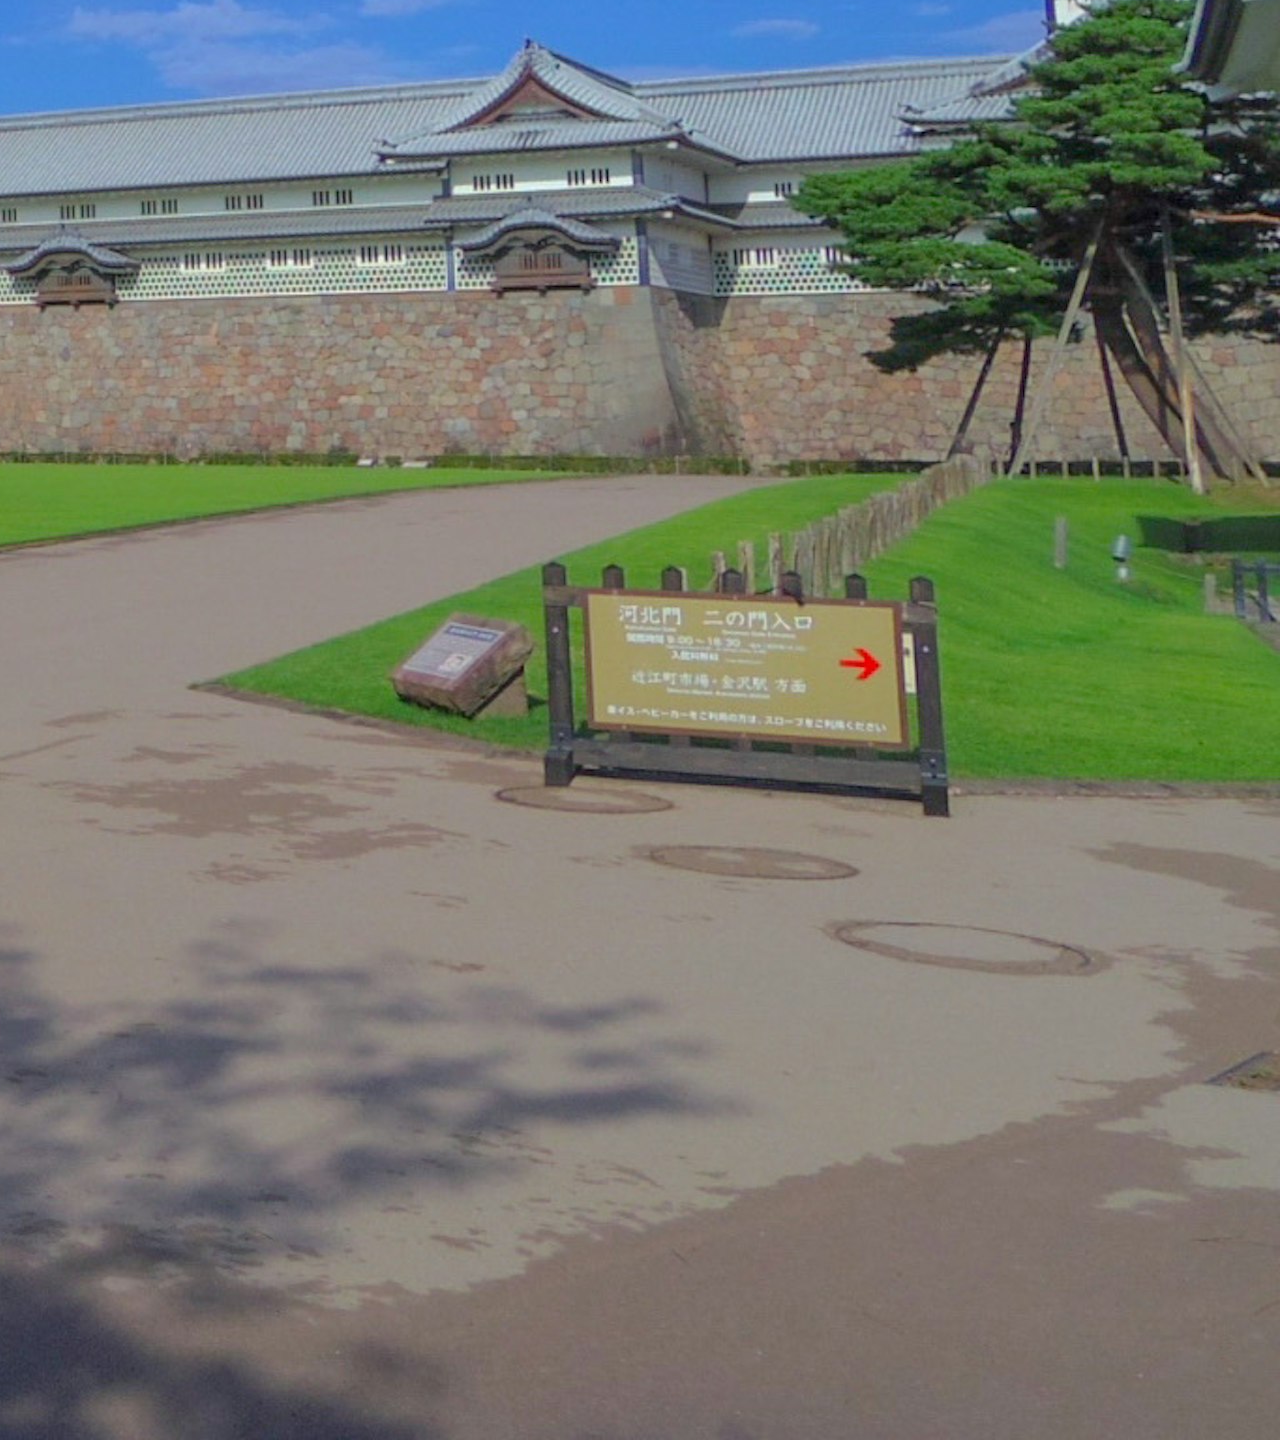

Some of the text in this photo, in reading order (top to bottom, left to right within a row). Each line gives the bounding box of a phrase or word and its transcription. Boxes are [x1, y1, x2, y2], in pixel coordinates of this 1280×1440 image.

[619, 605, 682, 626] 河北門
[702, 609, 813, 631] 二の門入口
